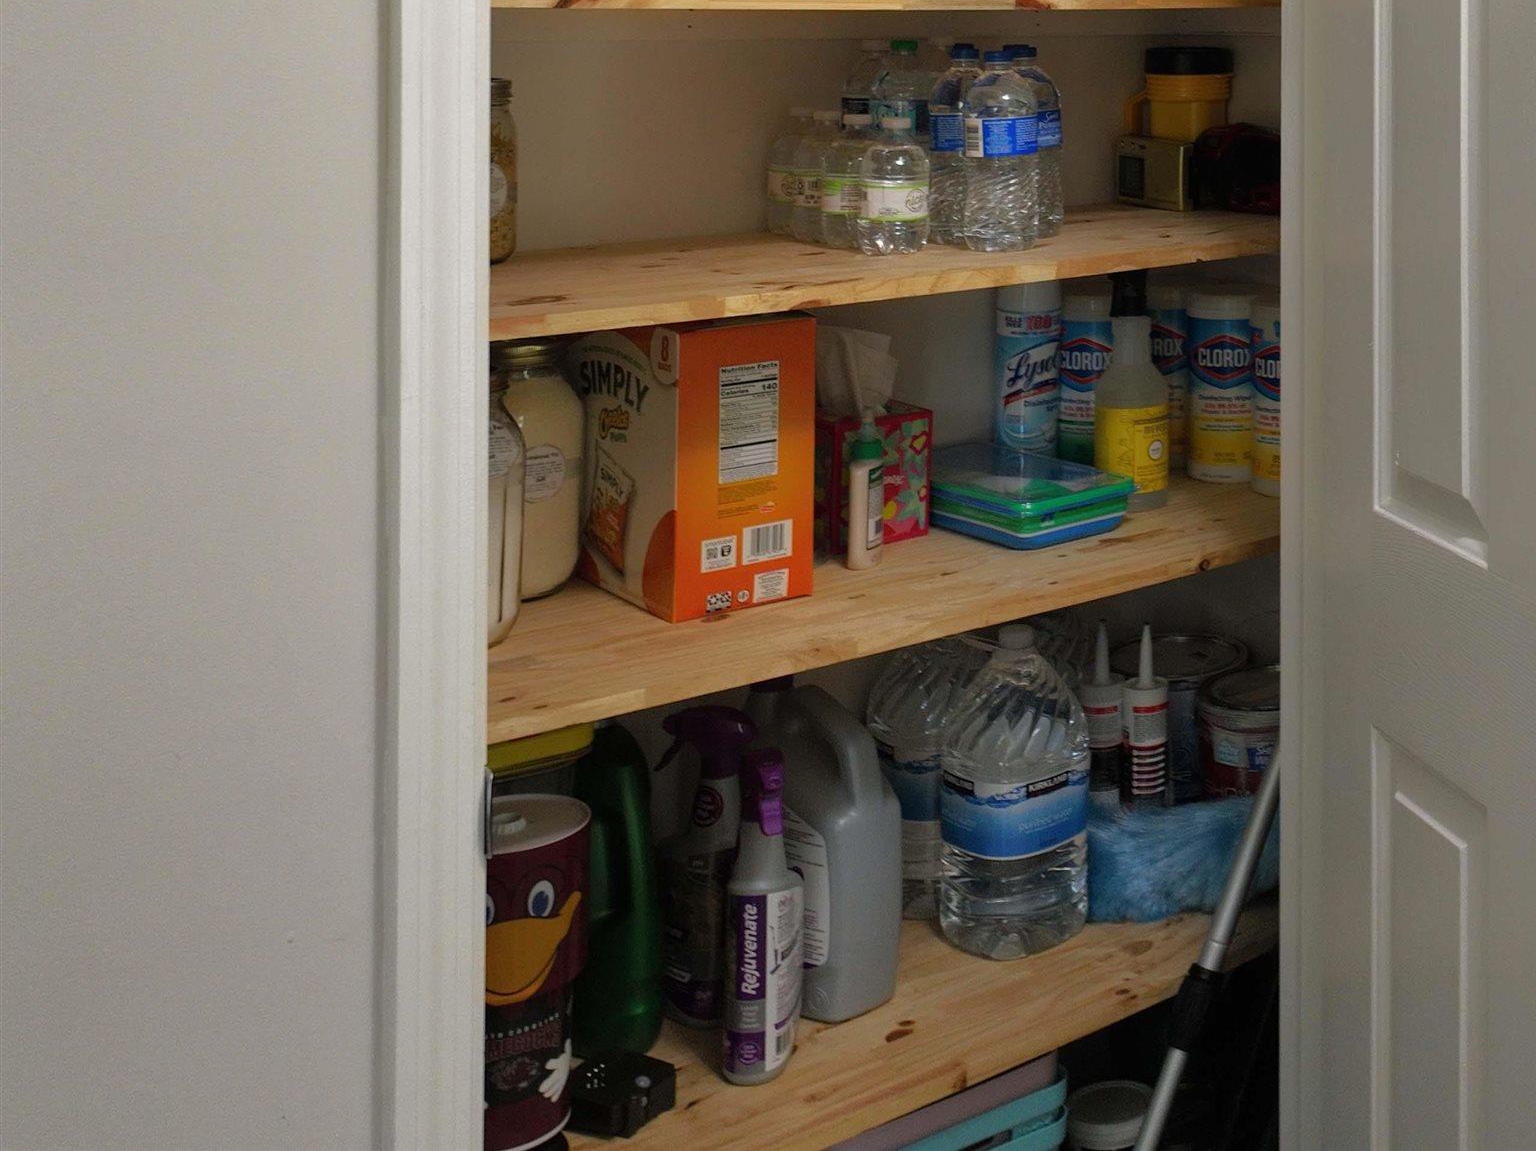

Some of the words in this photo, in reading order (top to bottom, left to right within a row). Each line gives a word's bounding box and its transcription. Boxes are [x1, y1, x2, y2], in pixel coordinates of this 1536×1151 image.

[661, 335, 669, 362] 8
[1152, 337, 1184, 357] ROX
[1197, 348, 1249, 368] CLOROX
[757, 362, 778, 370] Facts
[1007, 351, 1061, 390] Lyso
[580, 359, 650, 413] SIMPLY
[761, 382, 778, 392] 140
[1028, 771, 1069, 793] KIRKLAND
[740, 903, 759, 996] Rejuvenate
